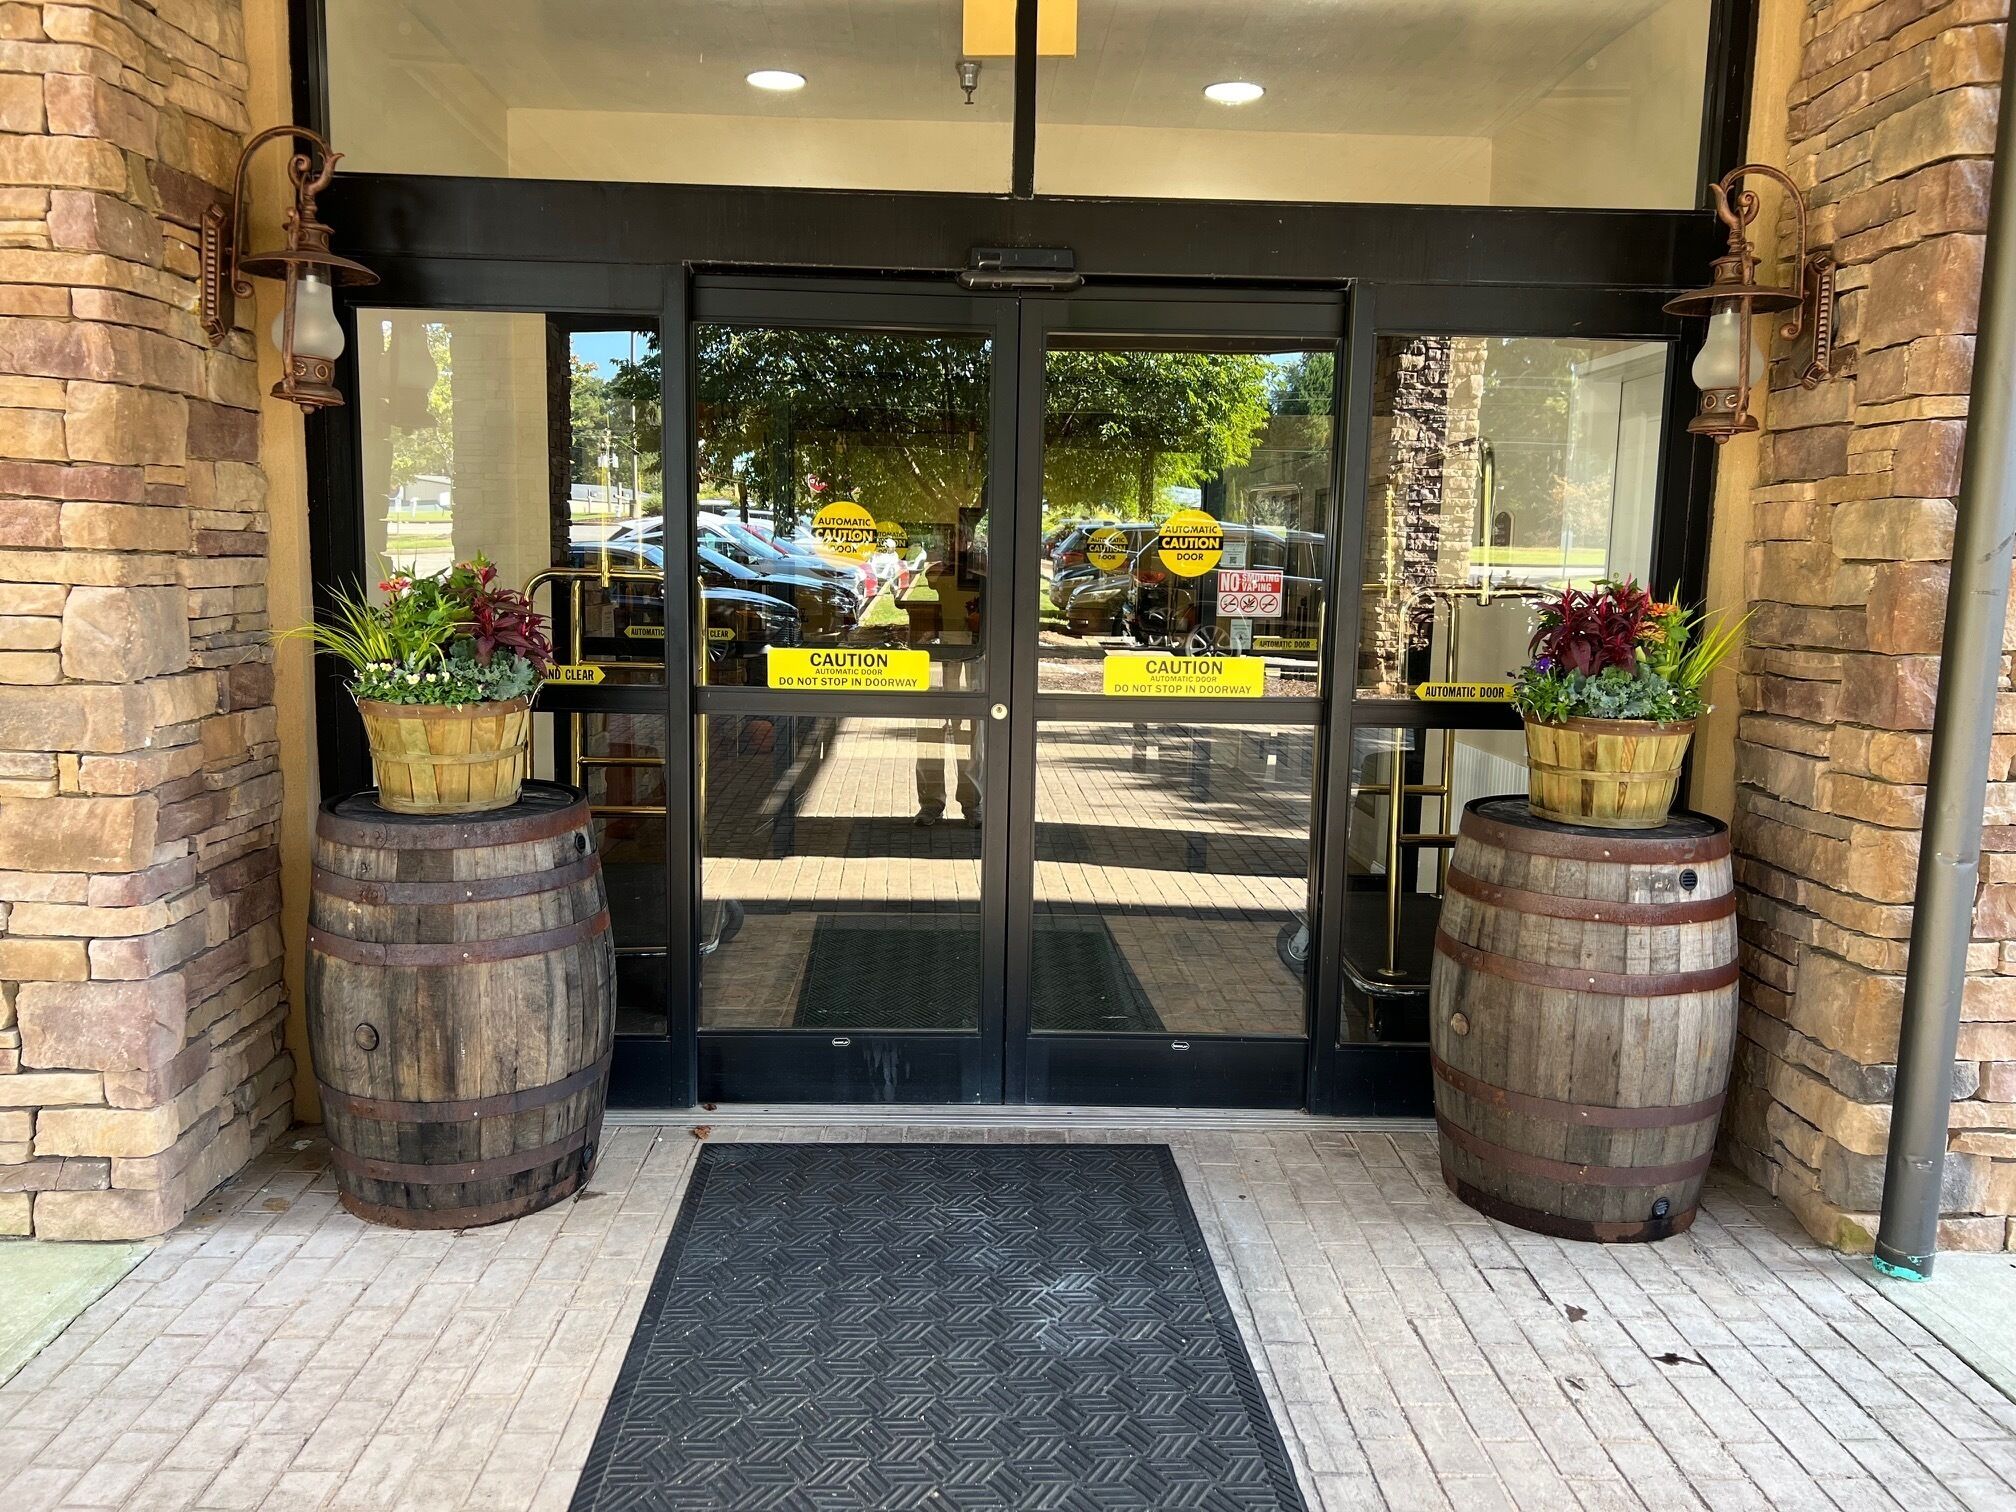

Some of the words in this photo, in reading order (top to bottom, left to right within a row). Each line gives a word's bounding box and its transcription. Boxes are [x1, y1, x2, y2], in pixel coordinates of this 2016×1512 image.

[818, 517, 871, 527] AUTOMATIC
[1165, 525, 1217, 534] AUTOMATIC
[815, 528, 874, 543] CAUTION
[1089, 544, 1126, 552] CAUTION
[1161, 537, 1220, 549] CAUTION
[1176, 552, 1204, 561] DOOR
[1220, 572, 1240, 592] NO
[1242, 573, 1280, 583] SMOKING
[1242, 582, 1272, 592] VAPING
[630, 627, 665, 636] AUTOMATIC
[709, 629, 729, 638] CLEAR
[1259, 640, 1293, 648] AUTOMATIC
[1294, 640, 1311, 648] DOOR
[810, 653, 888, 668] CAUTION
[815, 668, 859, 676] AUTOMATIC
[1145, 660, 1223, 675] CAUTION
[565, 669, 595, 680] CLEAR
[779, 677, 794, 686] DO
[797, 677, 818, 686] NOT
[821, 677, 848, 686] STOP
[851, 678, 862, 686] IN
[865, 678, 918, 687] DOORWAY
[1114, 684, 1129, 693] DO
[1132, 684, 1153, 693] NOT
[1155, 685, 1182, 693] STOP
[1185, 685, 1196, 693] IN
[1199, 685, 1252, 695] DOORWAY
[1425, 686, 1476, 698] AUTOMATIC
[1480, 686, 1505, 698] DOOR
